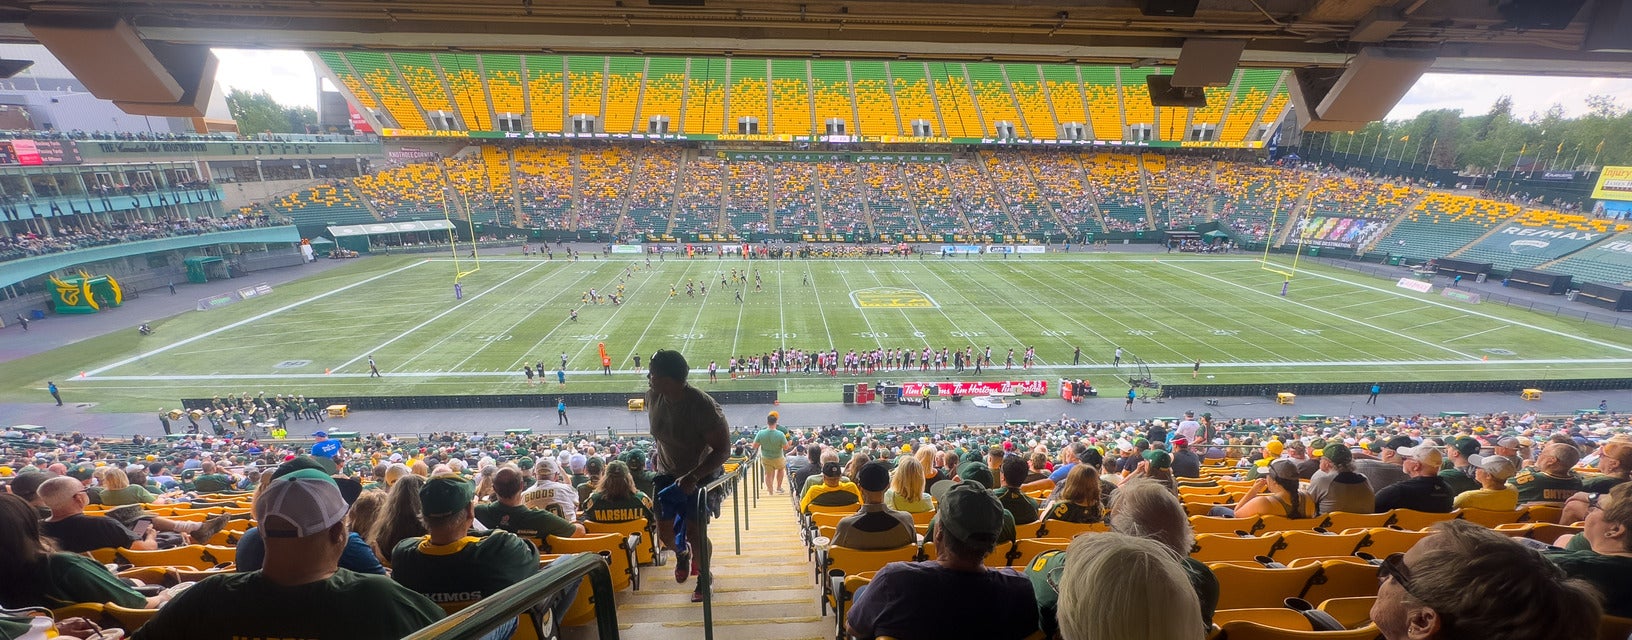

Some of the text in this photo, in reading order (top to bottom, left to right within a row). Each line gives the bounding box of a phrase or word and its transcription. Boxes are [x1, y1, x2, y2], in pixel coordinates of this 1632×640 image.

[1605, 167, 1630, 178] Injury
[1501, 226, 1599, 240] RE/MAX
[905, 385, 920, 394] Tim
[953, 382, 967, 393] Tim
[967, 382, 998, 394] Hortons
[525, 488, 555, 503] GOODS
[595, 507, 645, 520] MARSHALL
